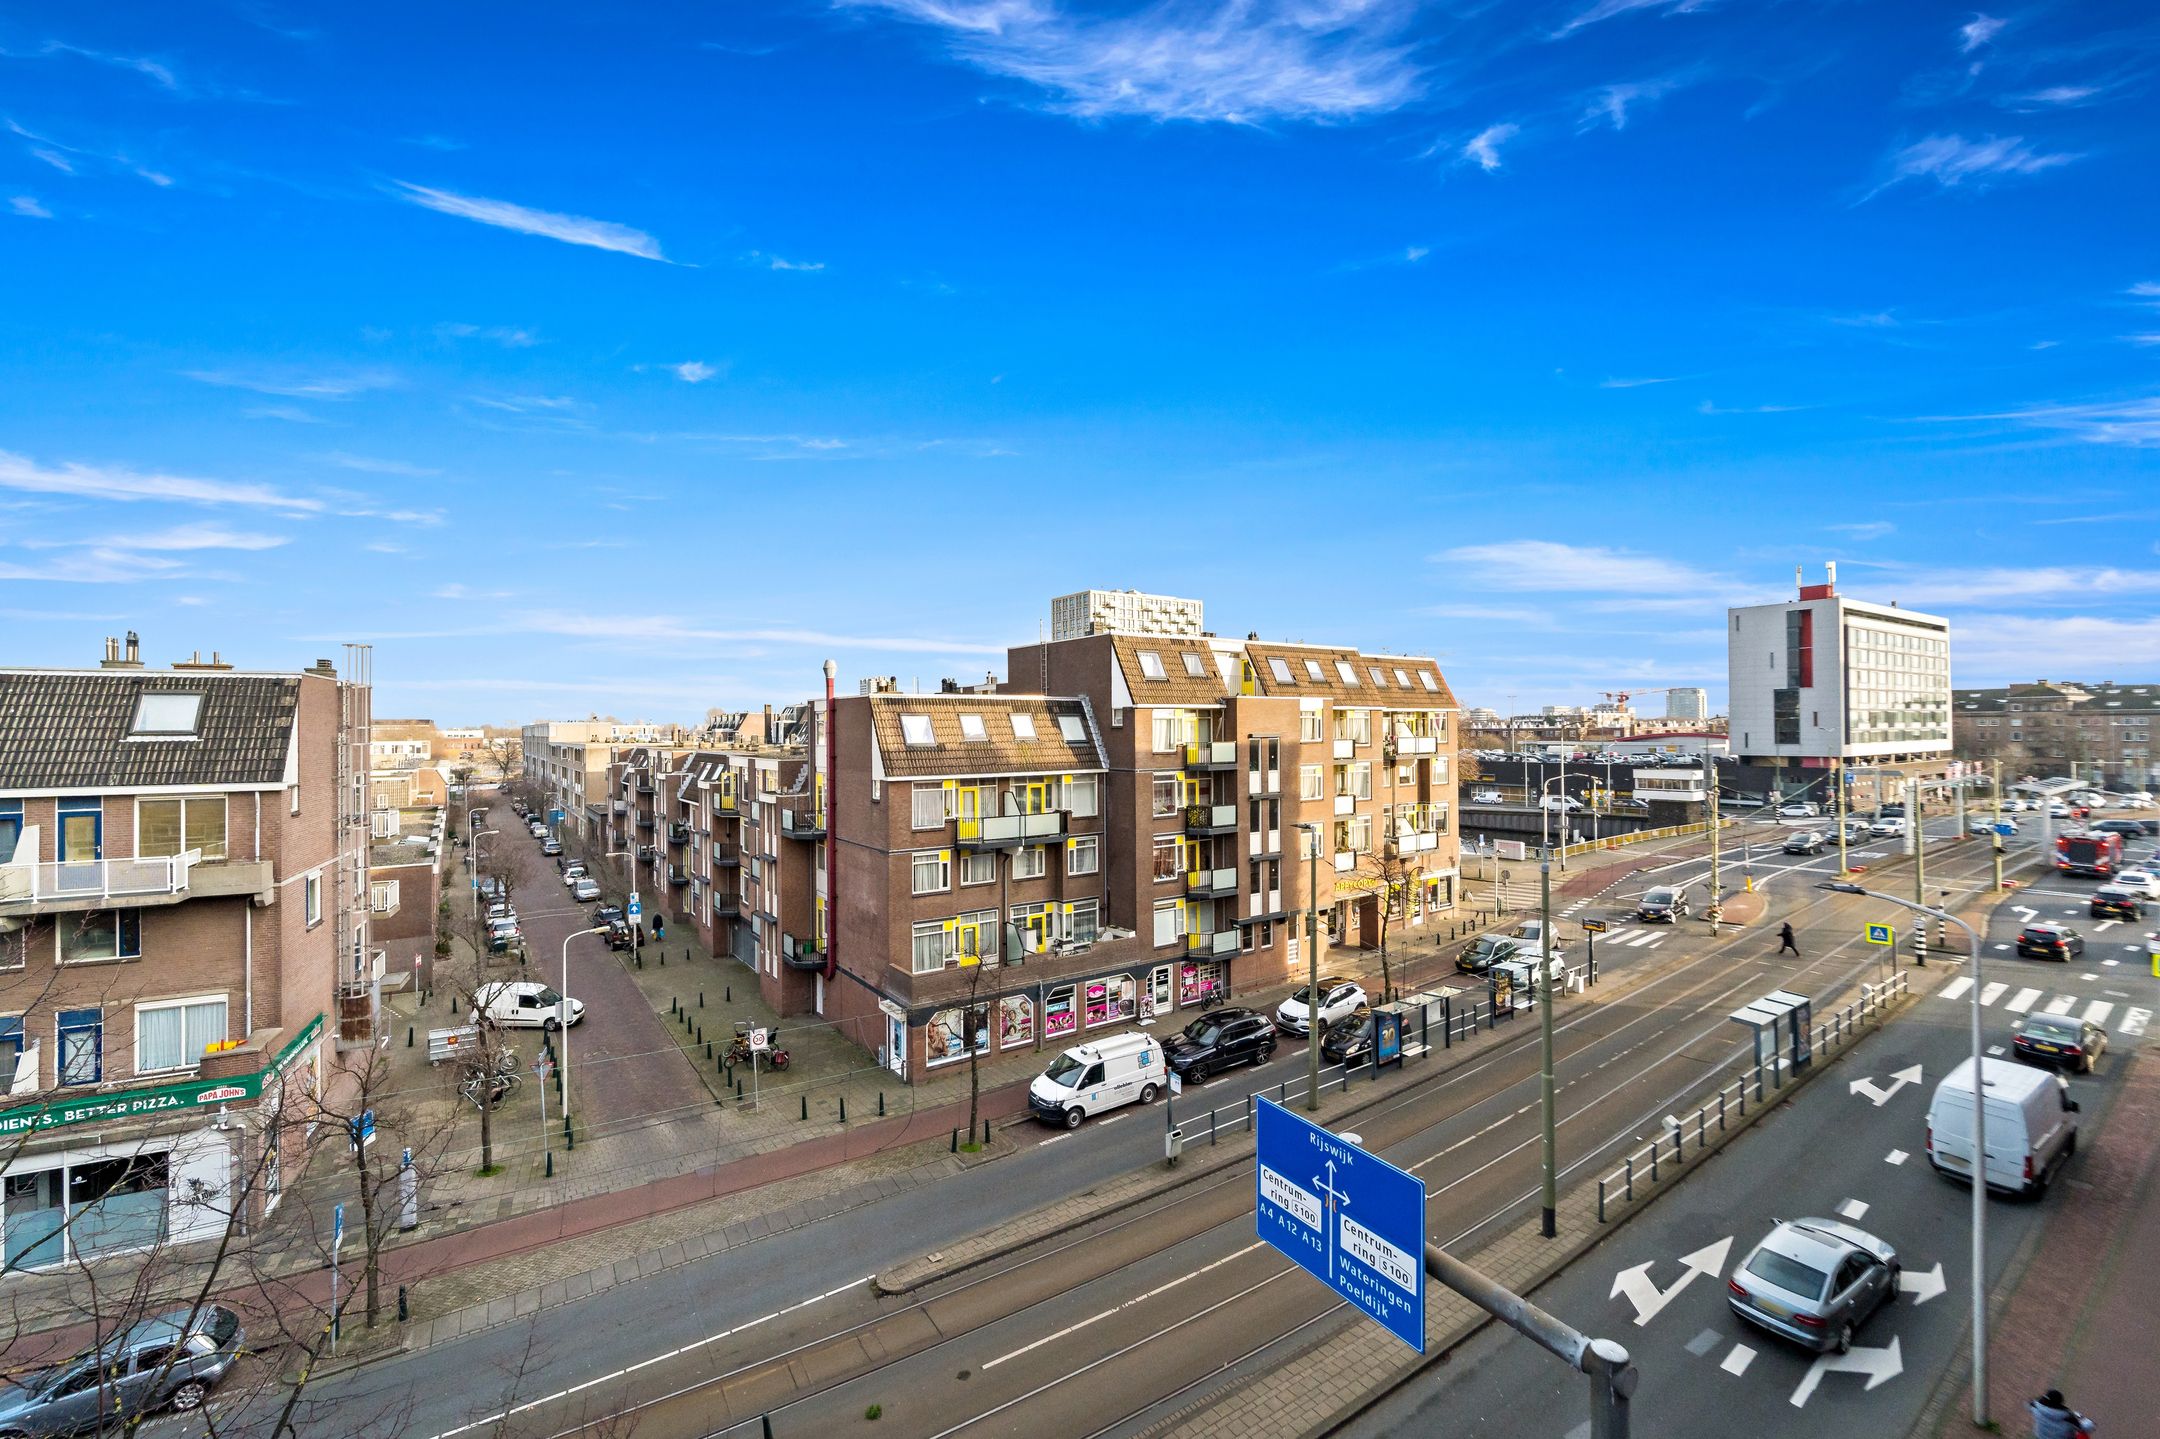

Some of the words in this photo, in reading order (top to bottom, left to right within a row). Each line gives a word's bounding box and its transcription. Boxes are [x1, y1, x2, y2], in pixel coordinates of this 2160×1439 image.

[64, 1103, 127, 1121] BETTER
[133, 1095, 184, 1111] PIZZA.
[199, 1091, 218, 1101] PAPA
[1310, 1132, 1353, 1165] Rijswijk
[1263, 1168, 1307, 1201] Centrum-
[1270, 1189, 1289, 1210] ring
[1343, 1219, 1398, 1259] Centrum-
[1353, 1243, 1376, 1267] ring
[1339, 1255, 1411, 1314] Wateringen
[1340, 1274, 1389, 1319] Poeldijk
